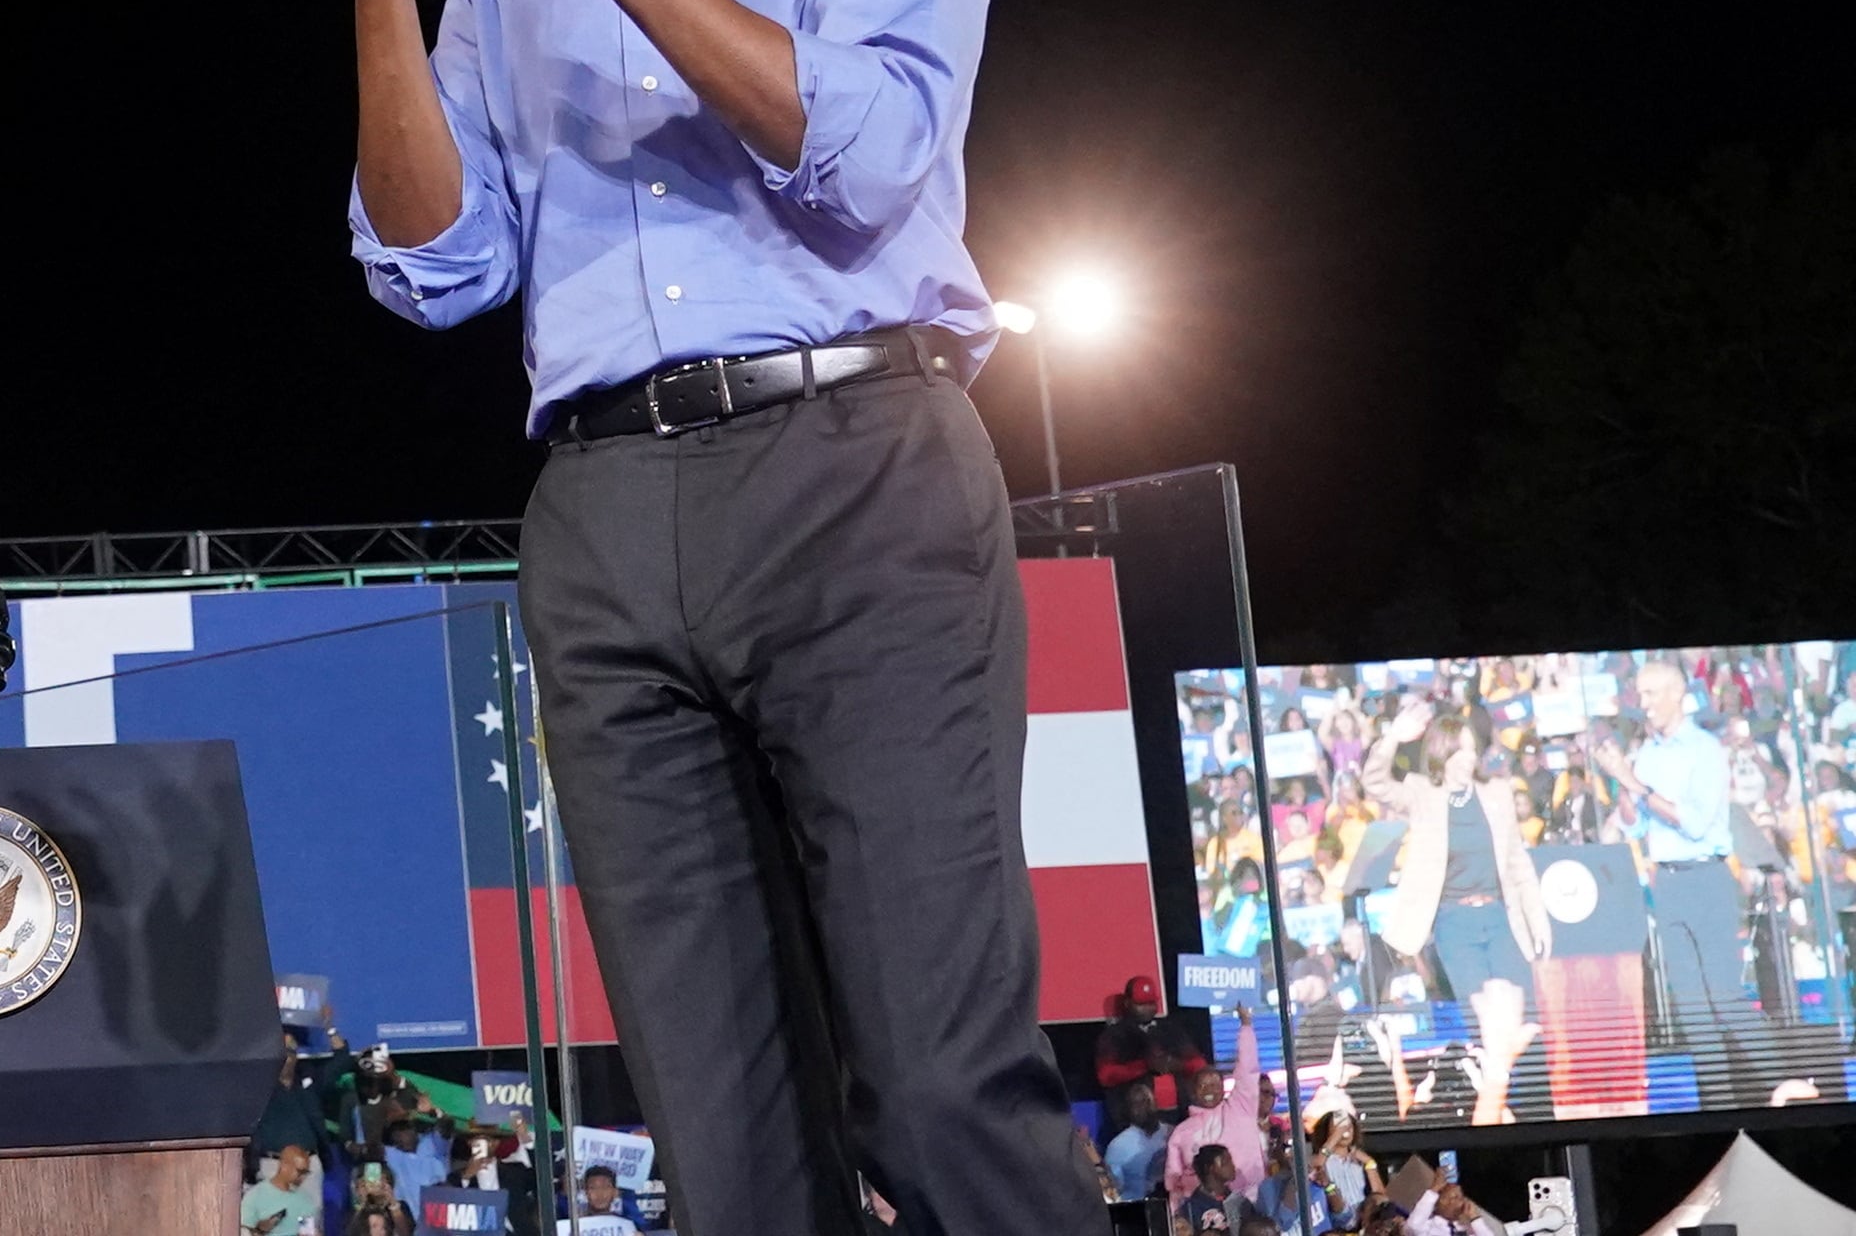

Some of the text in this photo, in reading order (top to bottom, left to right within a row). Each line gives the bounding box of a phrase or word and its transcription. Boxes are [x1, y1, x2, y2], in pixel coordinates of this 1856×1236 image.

[12, 822, 75, 906] UNITED
[11, 921, 75, 1000] STATES
[1184, 966, 1257, 989] FREEDOM
[275, 985, 320, 1011] MALA
[425, 1202, 498, 1231] KAMALA
